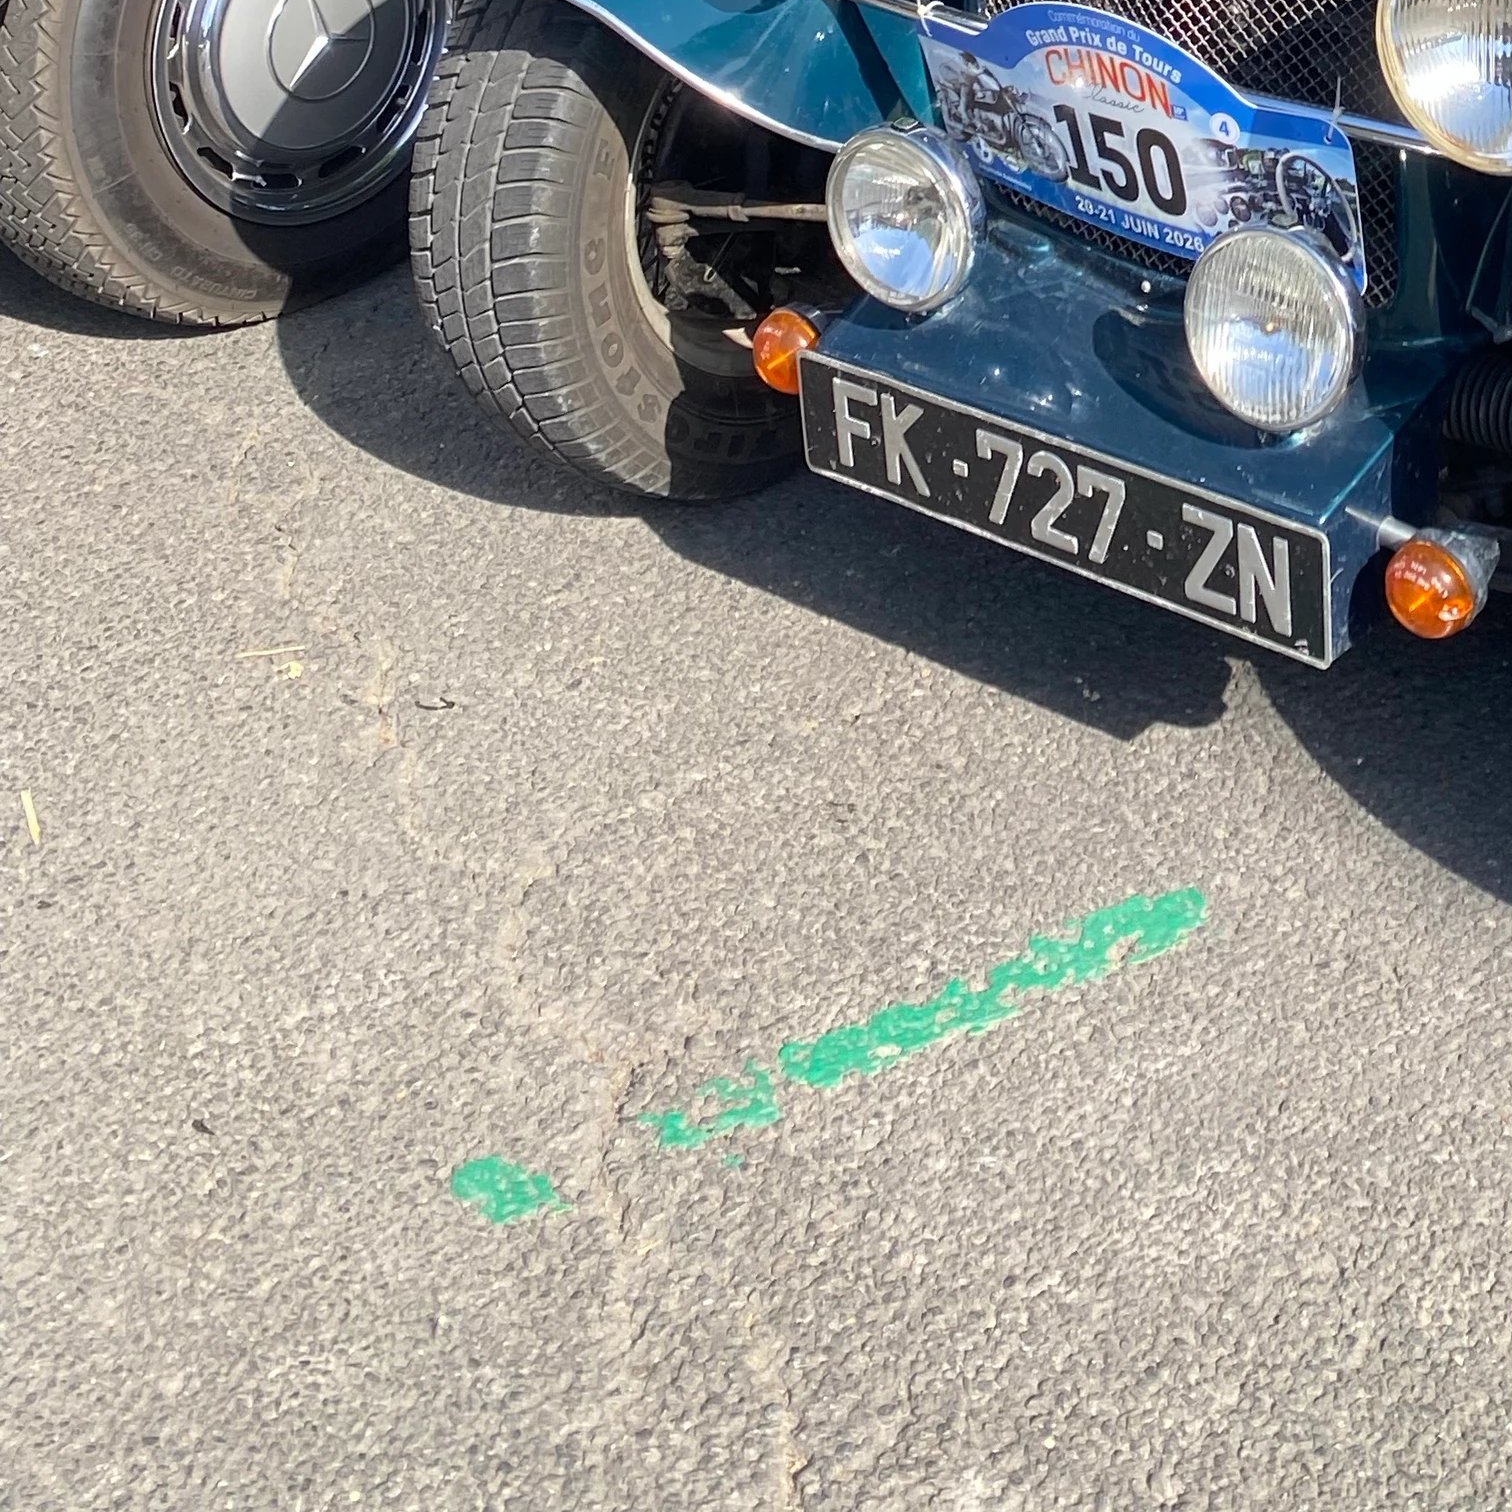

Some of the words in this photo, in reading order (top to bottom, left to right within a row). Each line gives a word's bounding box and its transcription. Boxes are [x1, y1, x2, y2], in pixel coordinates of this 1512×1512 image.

[1047, 8, 1126, 35] Commémoration
[1127, 27, 1141, 43] du
[1026, 25, 1067, 47] Grand
[1071, 26, 1103, 47] Prix
[1105, 34, 1128, 56] de
[1132, 44, 1183, 84] Tours
[1044, 46, 1174, 120] CHINON
[1218, 120, 1230, 137] 4
[1053, 104, 1188, 217] 150
[1074, 195, 1116, 225] 20-21
[1121, 213, 1160, 240] JUIN
